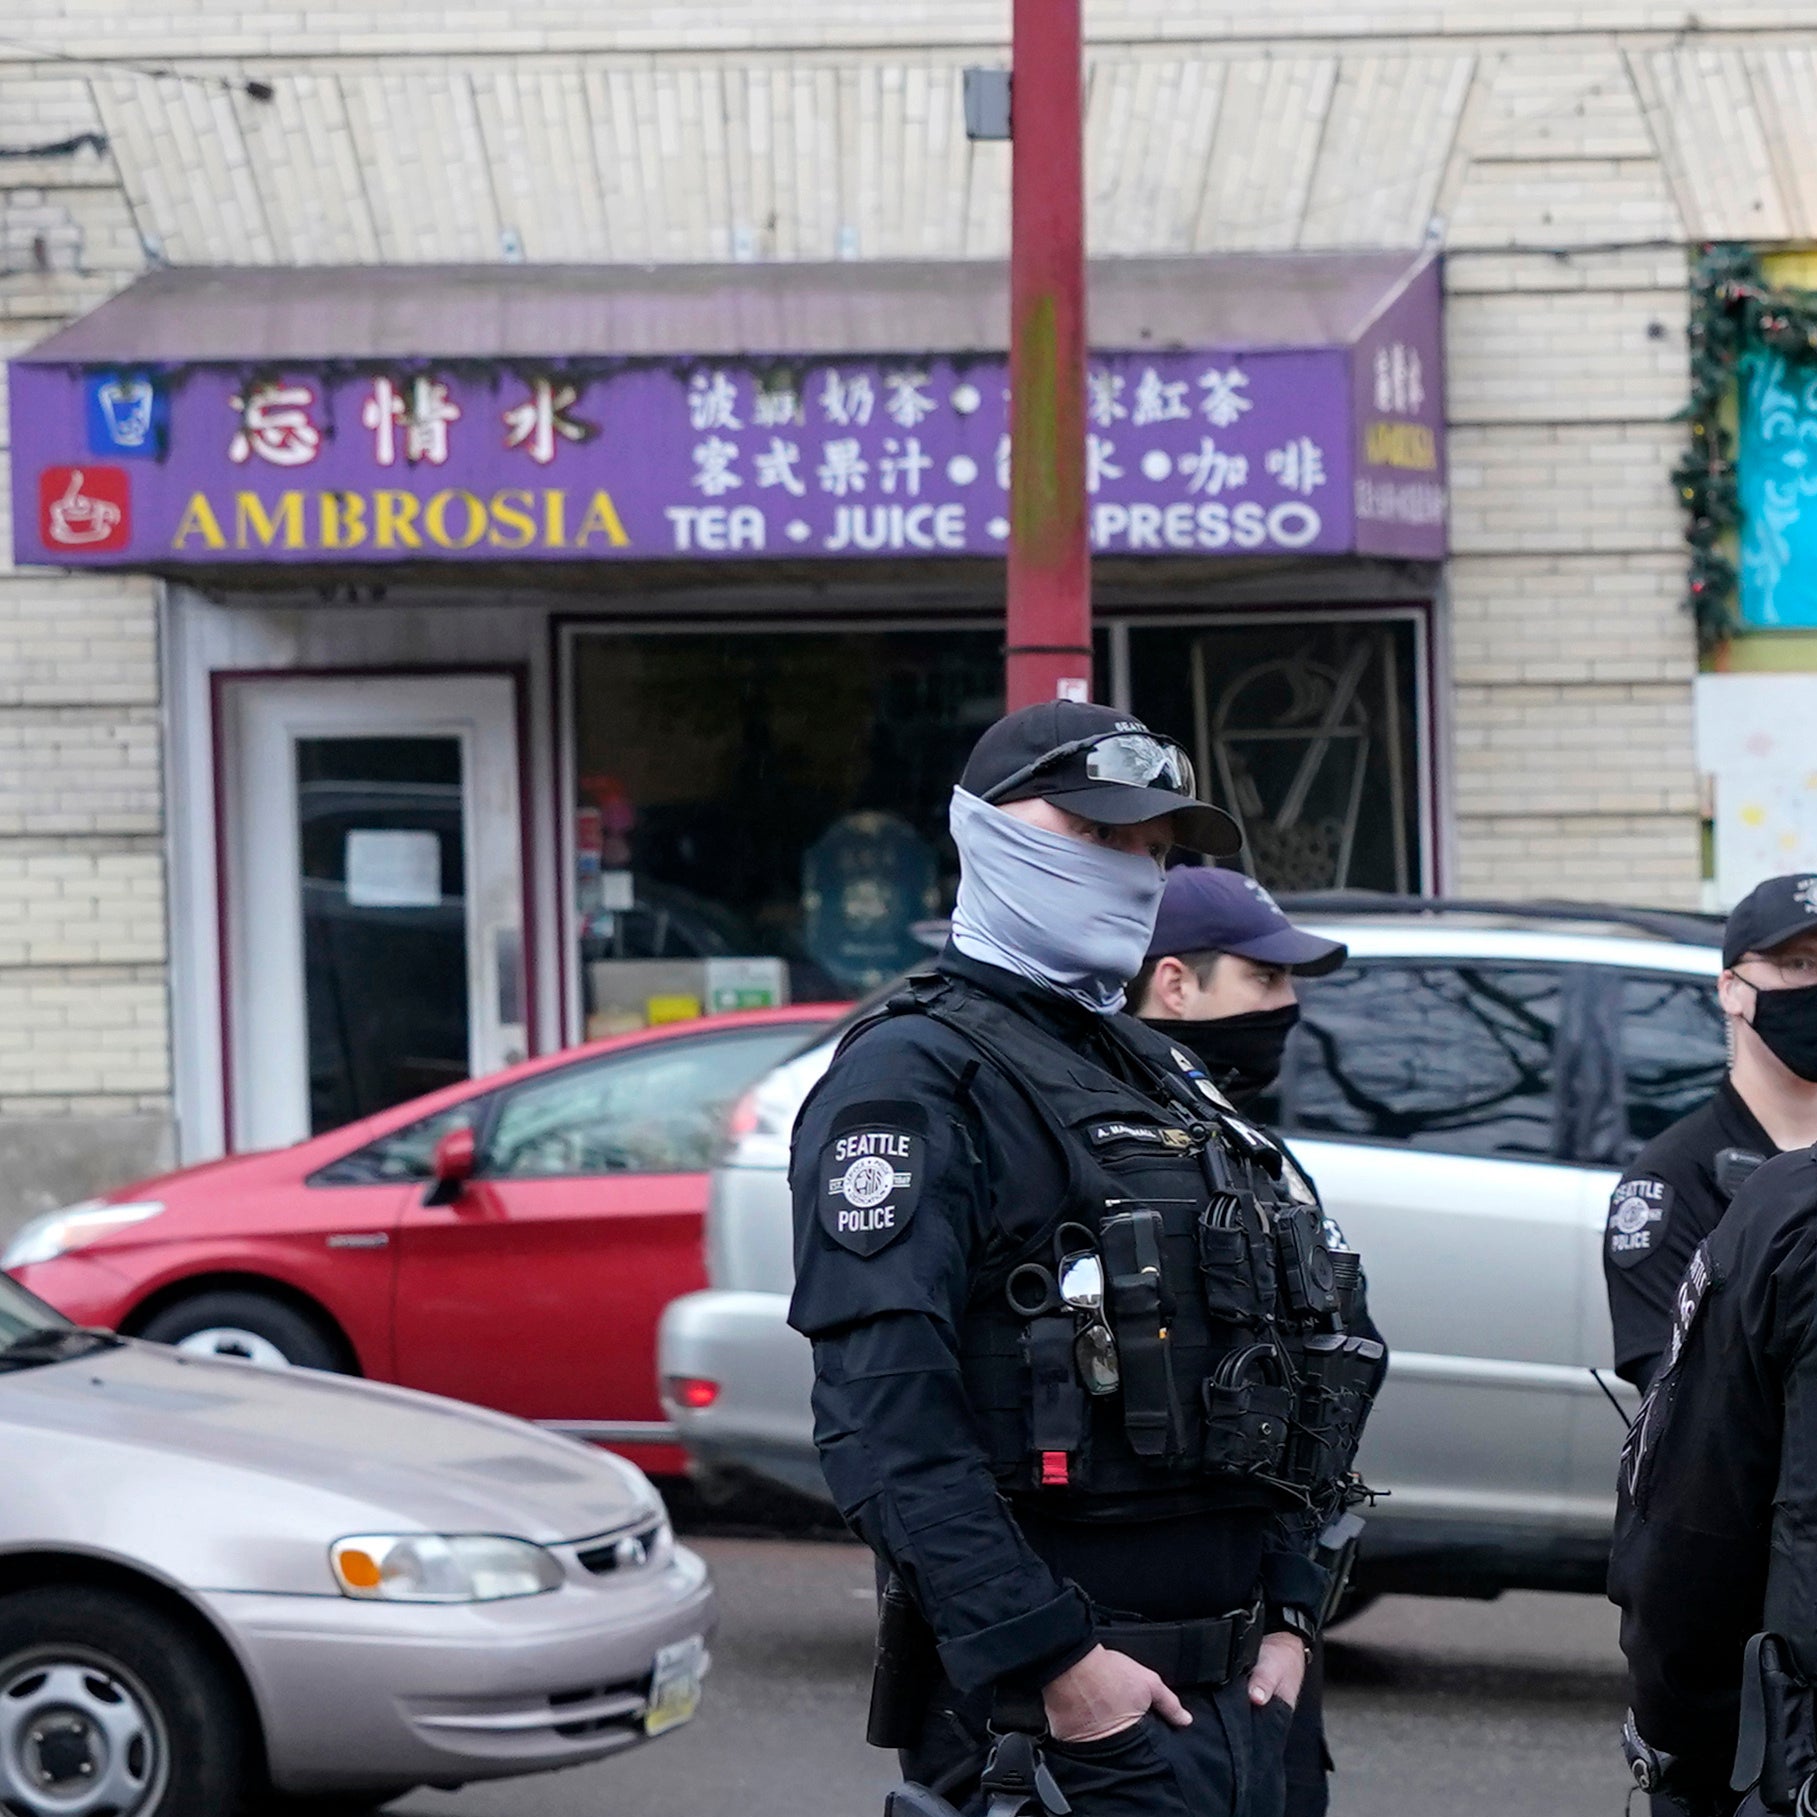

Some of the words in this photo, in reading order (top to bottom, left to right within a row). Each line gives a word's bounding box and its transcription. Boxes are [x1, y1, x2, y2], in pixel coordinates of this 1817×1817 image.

[171, 488, 632, 550] AMBROSIA
[664, 504, 766, 551] TEA
[823, 503, 967, 550] JUICE
[1091, 501, 1322, 549] PRESSO
[835, 1133, 911, 1162] SEATTLE
[838, 1205, 896, 1233] POLICE
